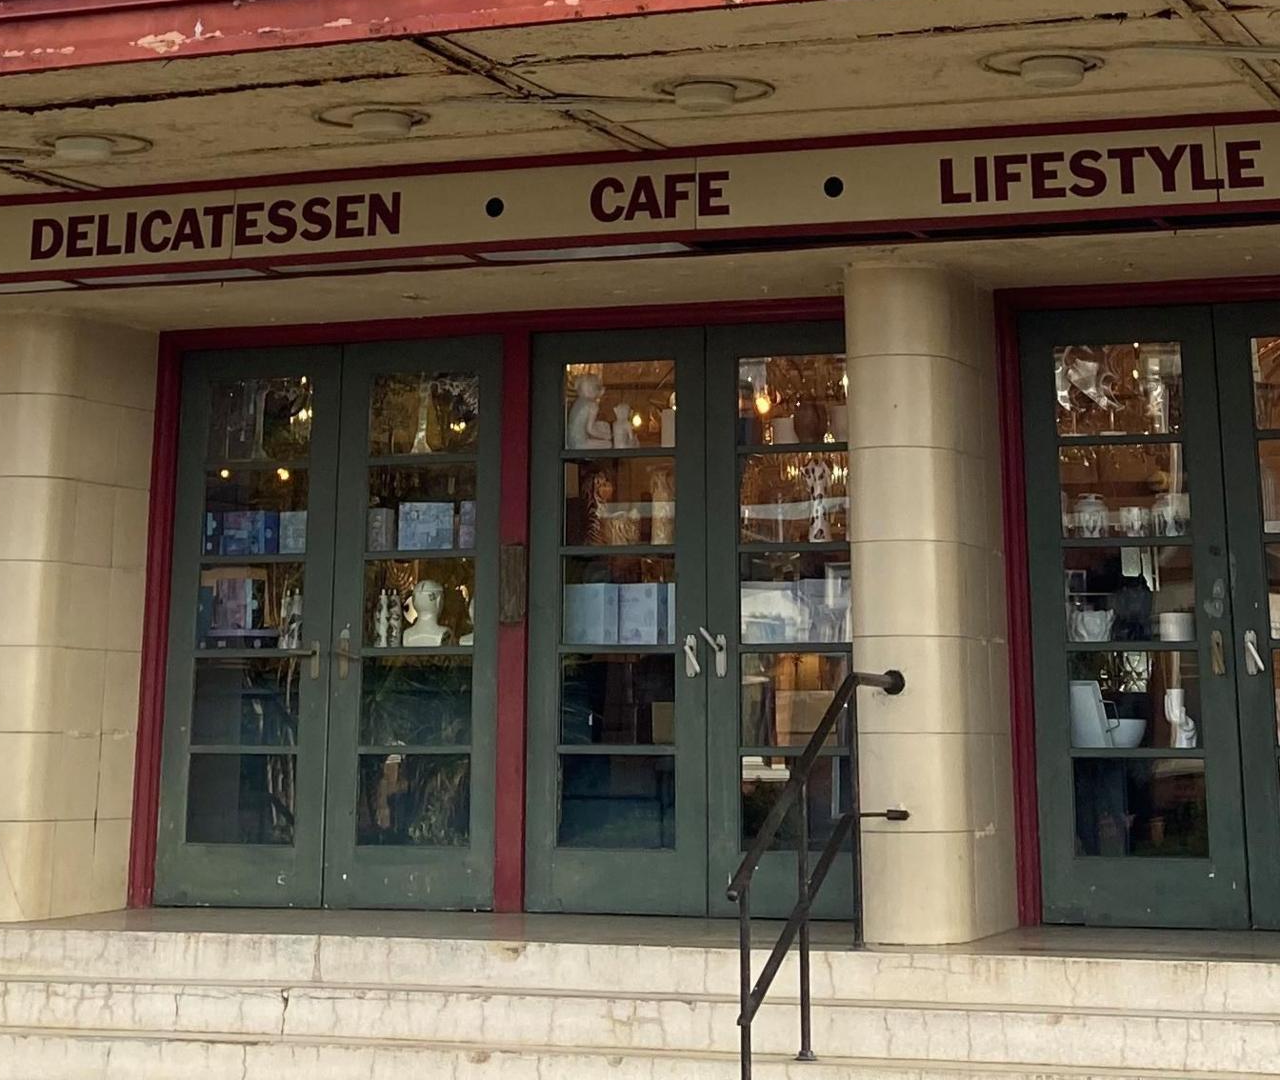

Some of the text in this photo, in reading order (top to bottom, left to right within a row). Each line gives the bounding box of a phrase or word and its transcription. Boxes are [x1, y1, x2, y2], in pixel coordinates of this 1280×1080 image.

[30, 191, 401, 260] DELICATESSEN
[589, 171, 730, 223] CAFE
[940, 140, 1264, 204] LIFESTYLE
